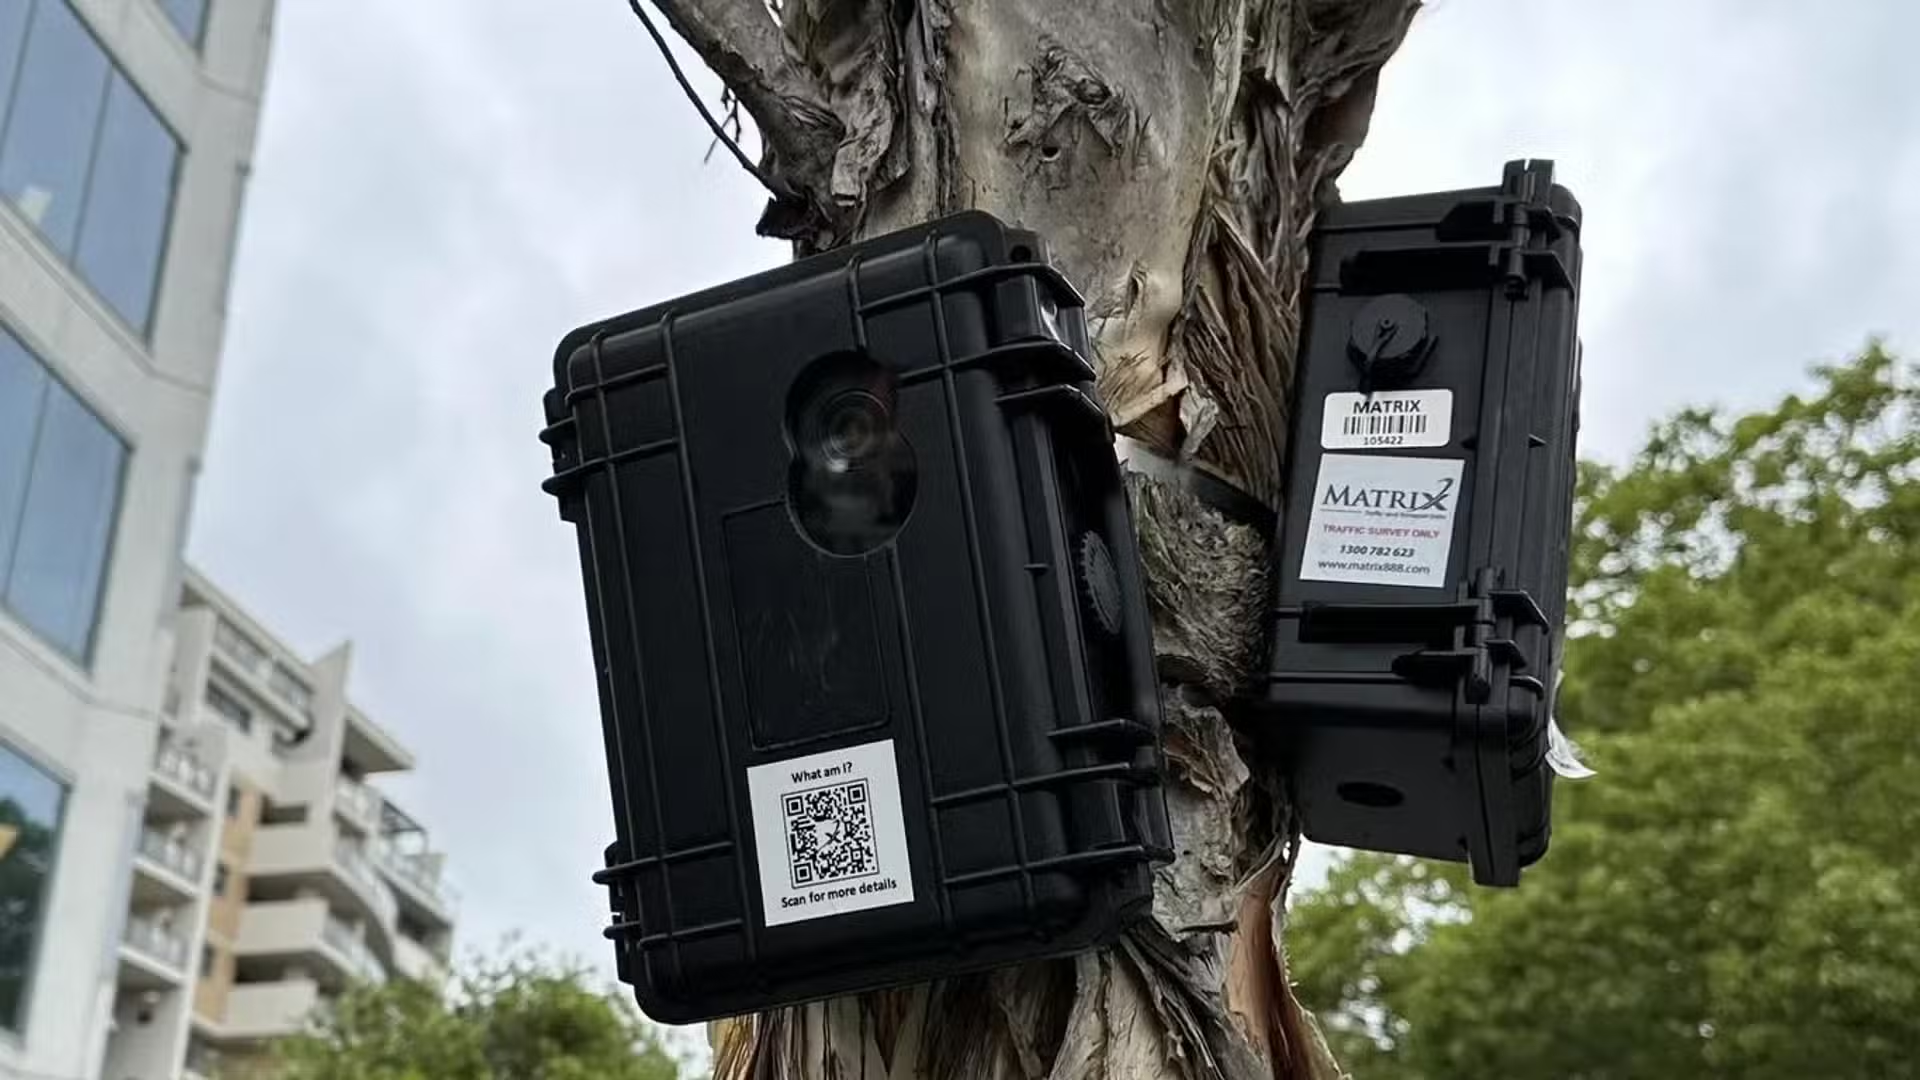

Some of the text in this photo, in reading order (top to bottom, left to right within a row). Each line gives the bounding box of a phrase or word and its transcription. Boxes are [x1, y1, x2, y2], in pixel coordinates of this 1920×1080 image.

[1353, 400, 1421, 414] MATRIX
[1364, 436, 1403, 445] 105422
[1323, 524, 1440, 538] TRAFFIC SURVEY ONLY
[1340, 544, 1415, 558] 1300 782 623
[1318, 560, 1430, 574] www.matrix888.com
[791, 761, 853, 783] What am I?
[781, 878, 897, 908] Scan for more details
